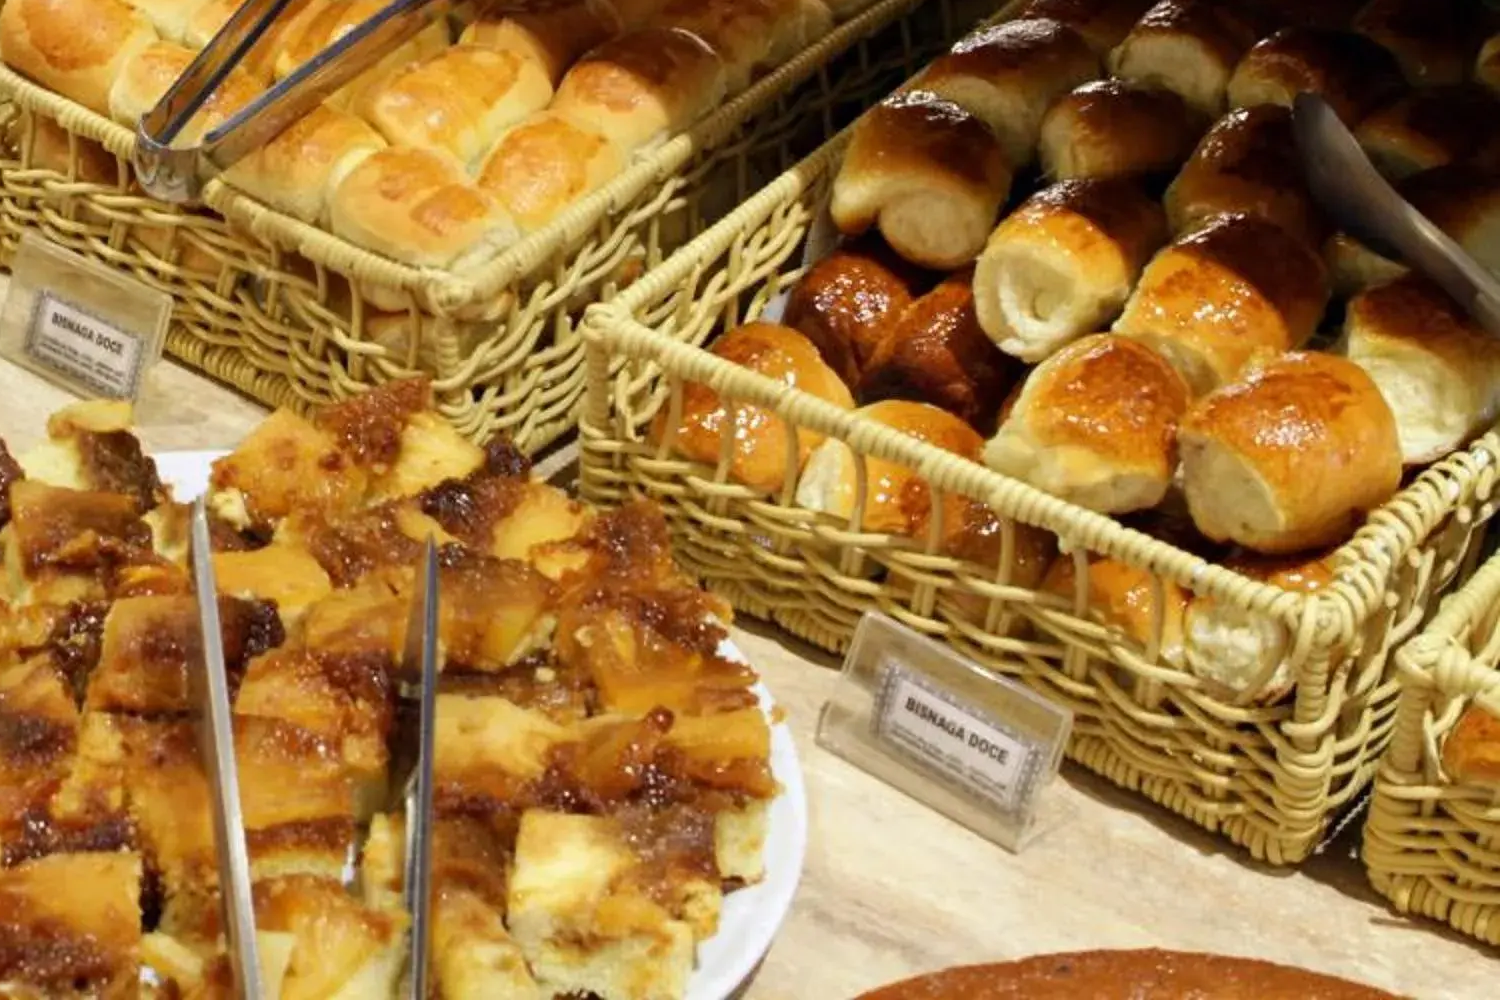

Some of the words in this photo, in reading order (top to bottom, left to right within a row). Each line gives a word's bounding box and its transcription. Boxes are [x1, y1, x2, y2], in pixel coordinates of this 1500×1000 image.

[95, 333, 124, 356] DOCE
[904, 696, 965, 742] BISNAGA
[968, 731, 1010, 766] DOCE
